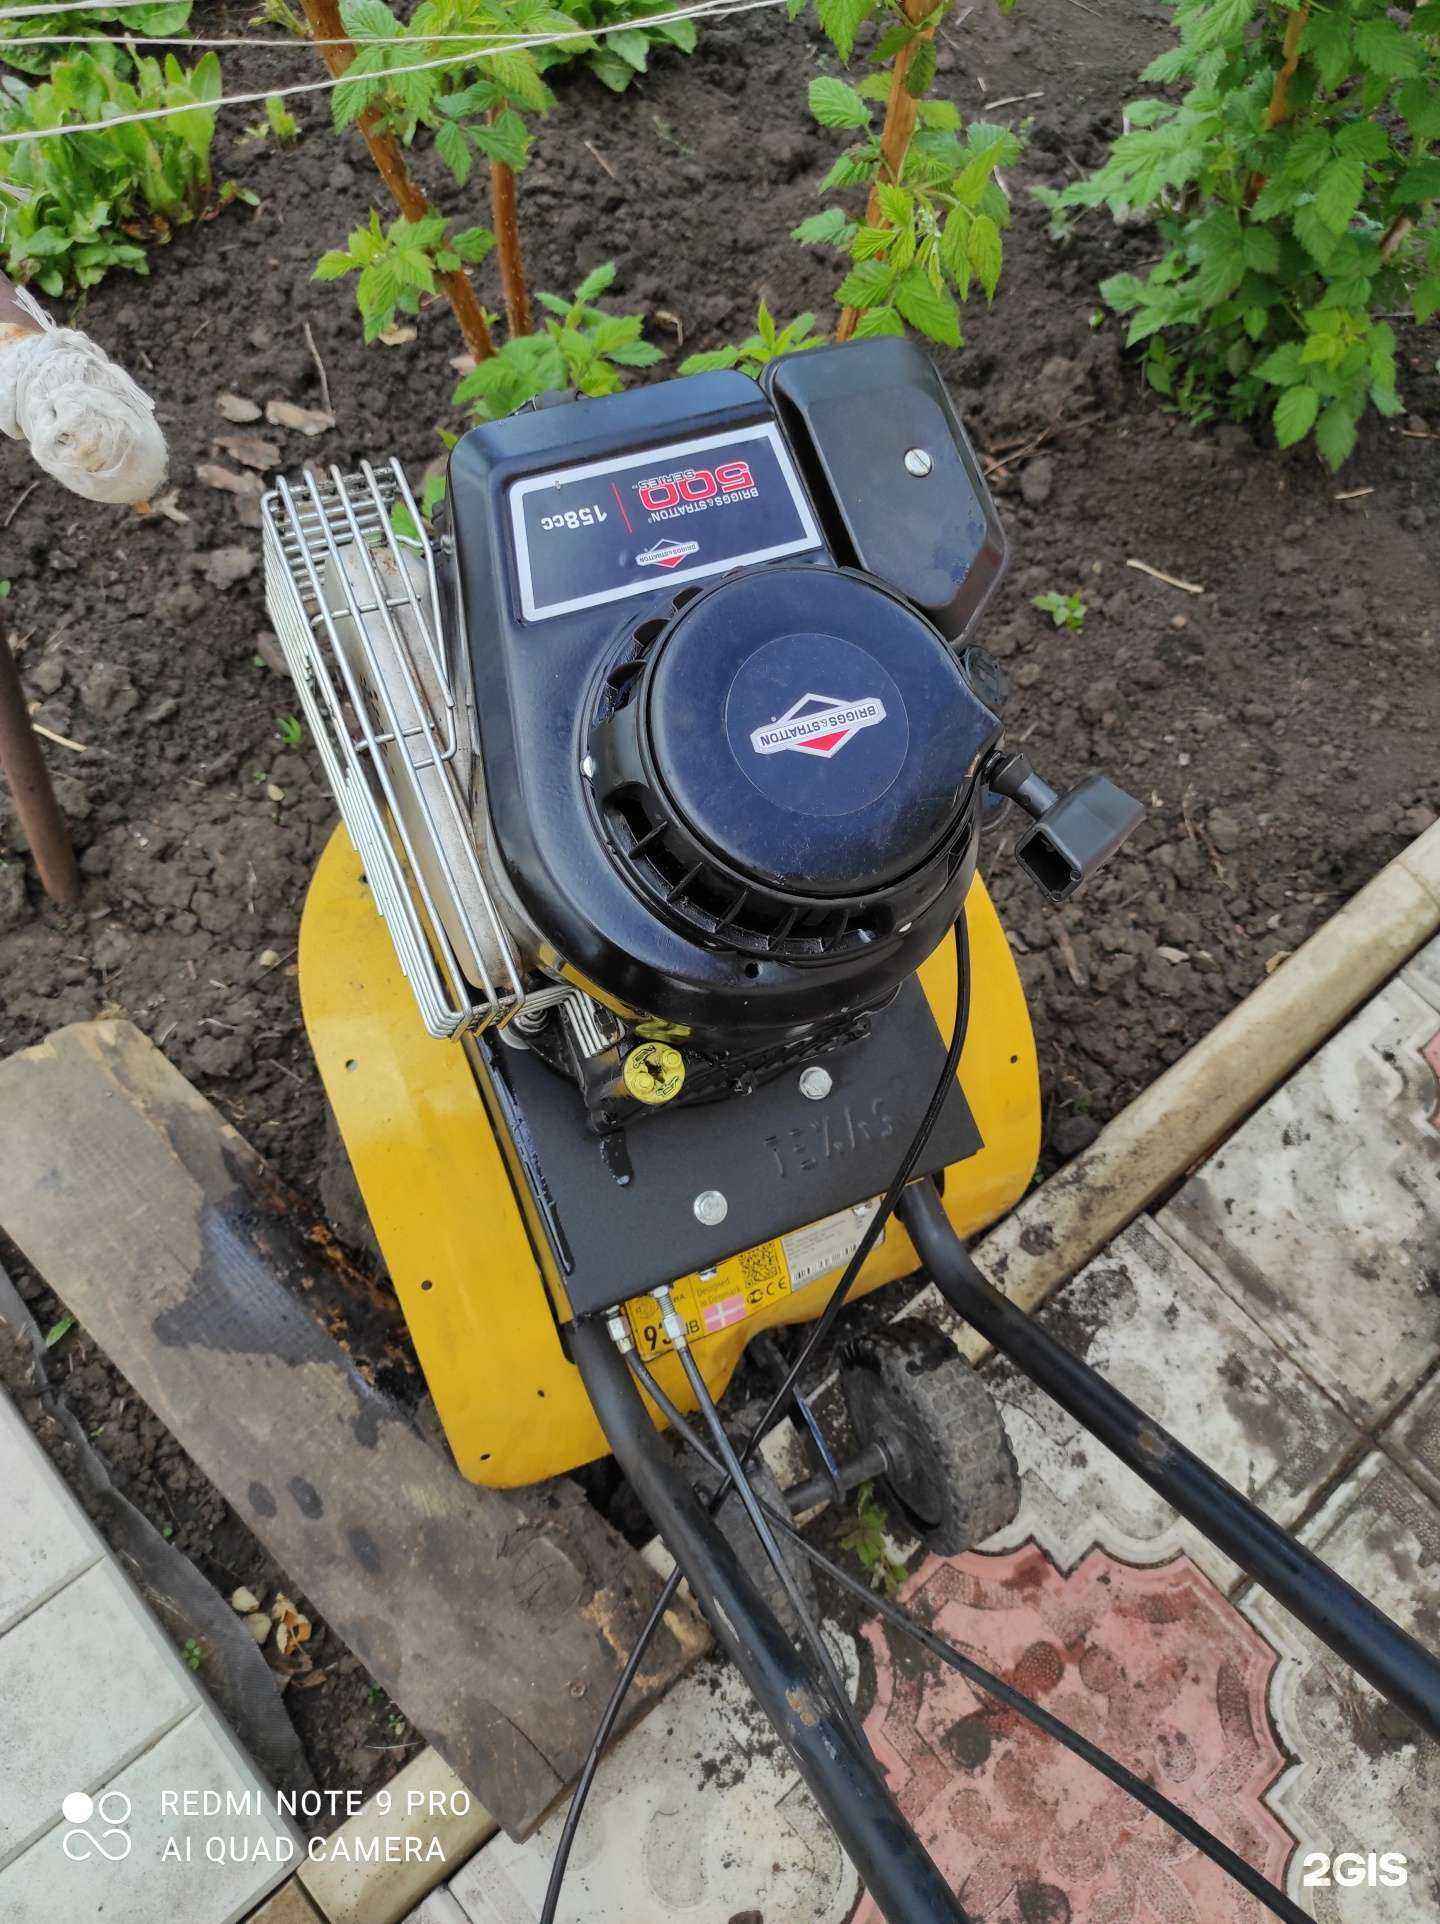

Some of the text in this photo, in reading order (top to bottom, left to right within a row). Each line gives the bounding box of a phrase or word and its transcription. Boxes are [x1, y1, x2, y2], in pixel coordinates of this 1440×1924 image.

[637, 470, 696, 491] SERIES
[638, 461, 755, 511] 500
[540, 504, 608, 530] 158cc
